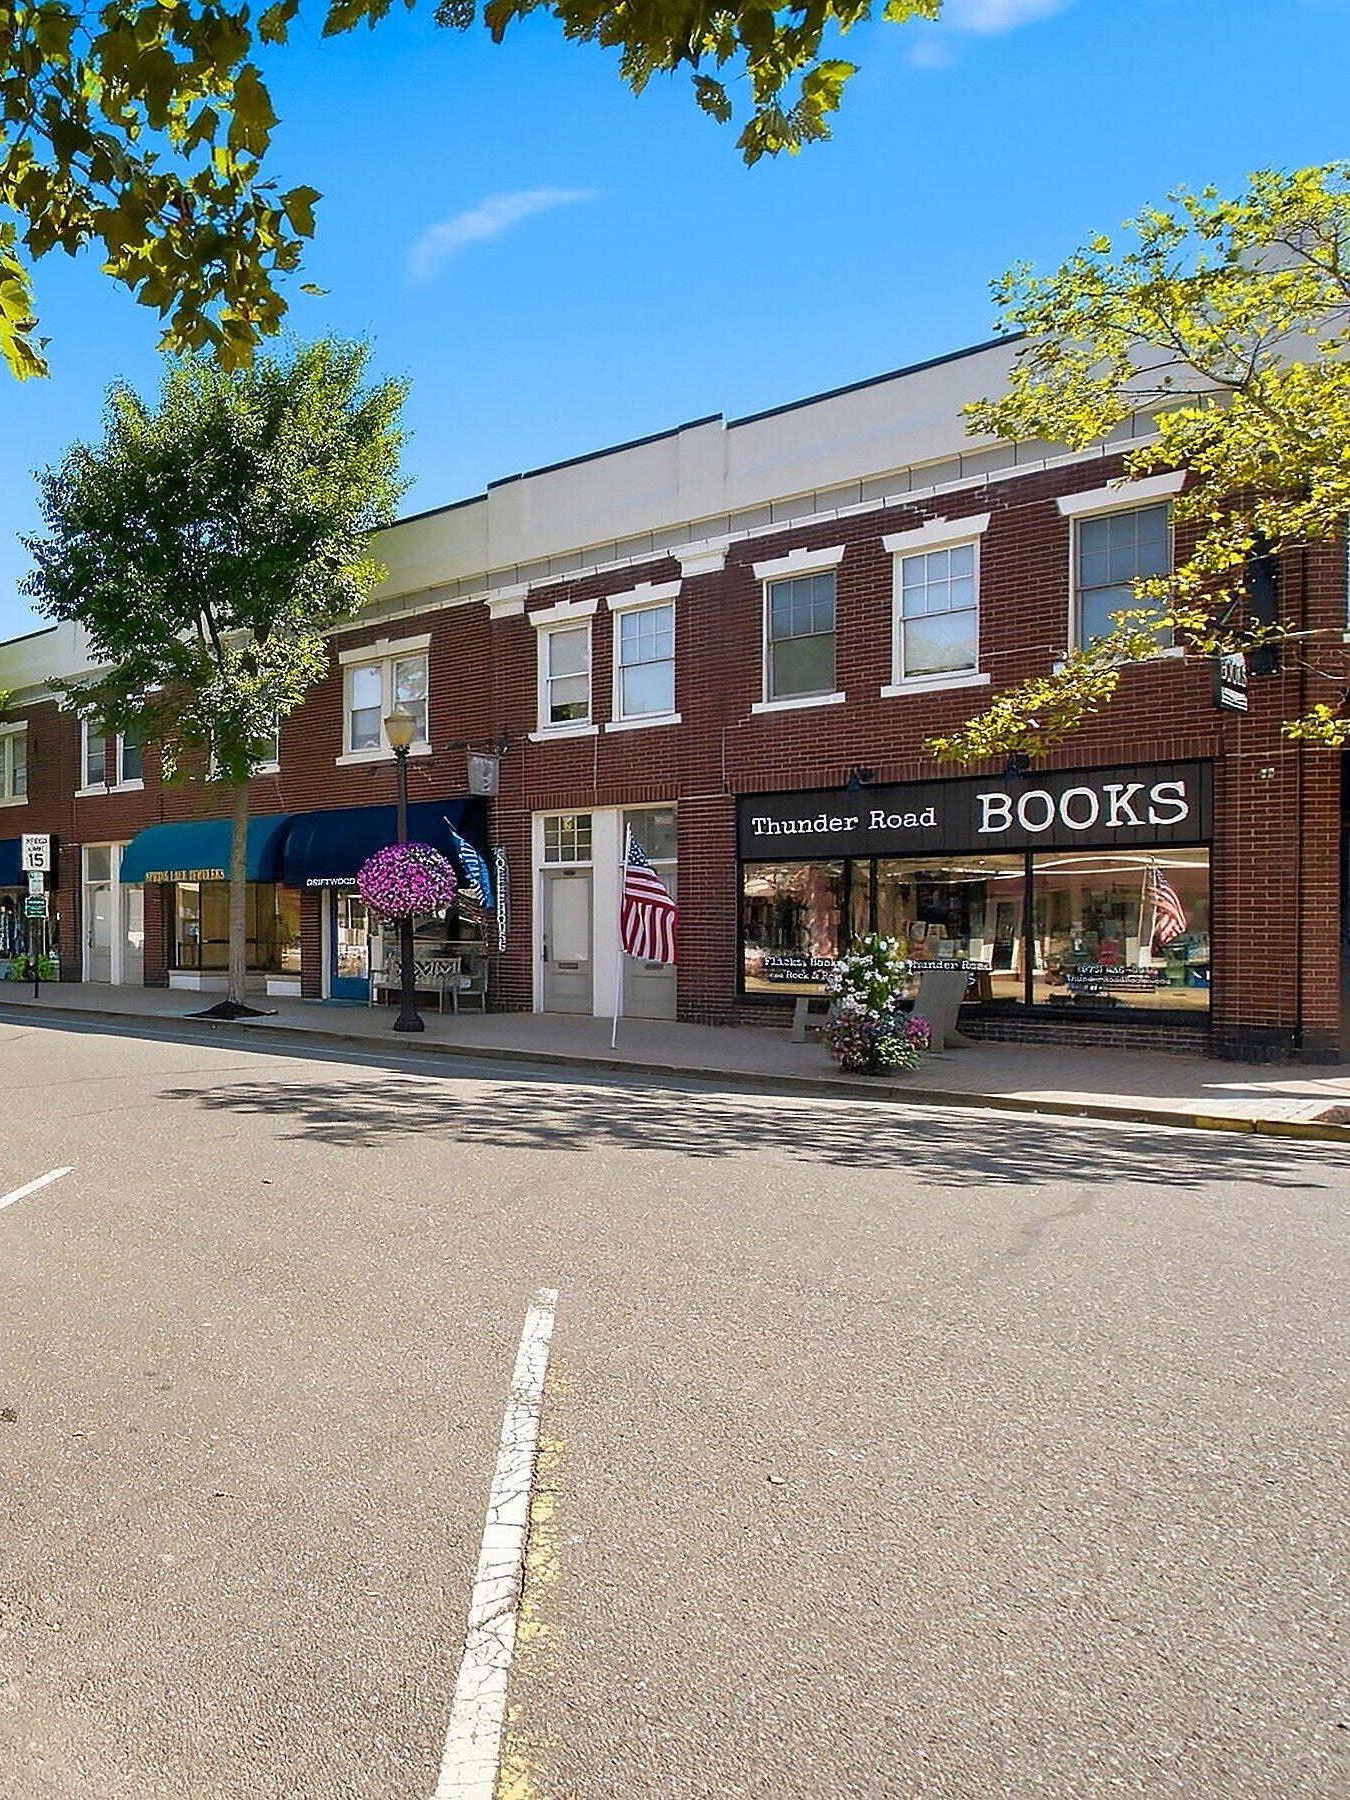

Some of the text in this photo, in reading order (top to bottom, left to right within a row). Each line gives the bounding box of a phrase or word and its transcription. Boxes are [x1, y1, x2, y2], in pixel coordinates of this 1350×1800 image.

[751, 781, 1189, 836] Thunder Road BOOKS
[29, 853, 44, 867] 15
[961, 960, 993, 971] Road
